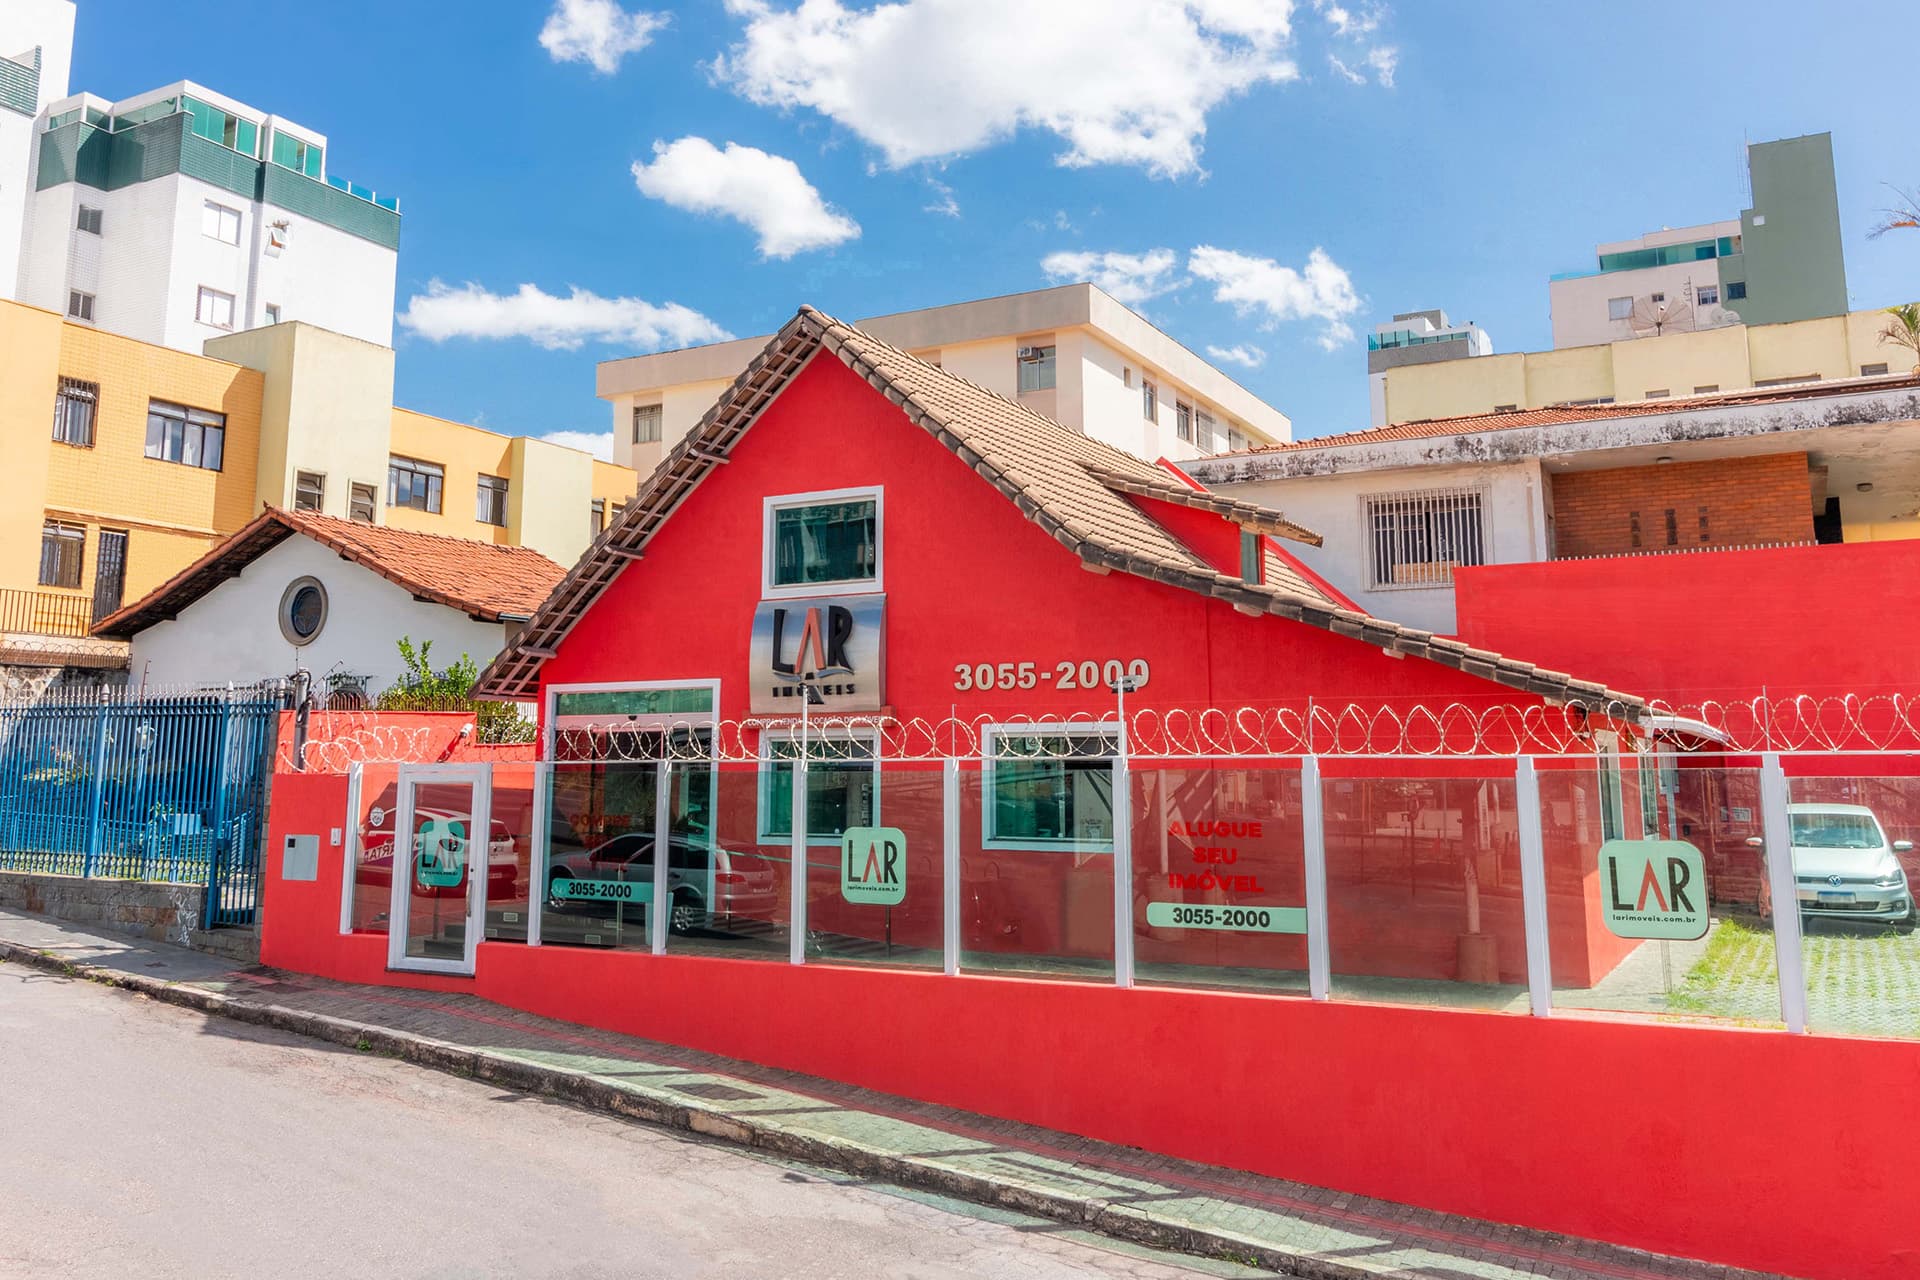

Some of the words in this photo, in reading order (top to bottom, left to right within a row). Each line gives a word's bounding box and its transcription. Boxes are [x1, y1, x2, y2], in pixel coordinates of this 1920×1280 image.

[772, 605, 854, 674] LAR
[954, 659, 1149, 691] 3055-2000
[1168, 821, 1263, 838] ALUGUE
[848, 840, 898, 884] LAR
[1193, 846, 1237, 865] SEU
[568, 882, 631, 898] 3055-2000
[1168, 869, 1264, 893] IMÓVEL
[1608, 856, 1695, 912] LAR
[1173, 907, 1271, 928] 3055-2000
[1612, 914, 1696, 923] larimoveis.com.br
